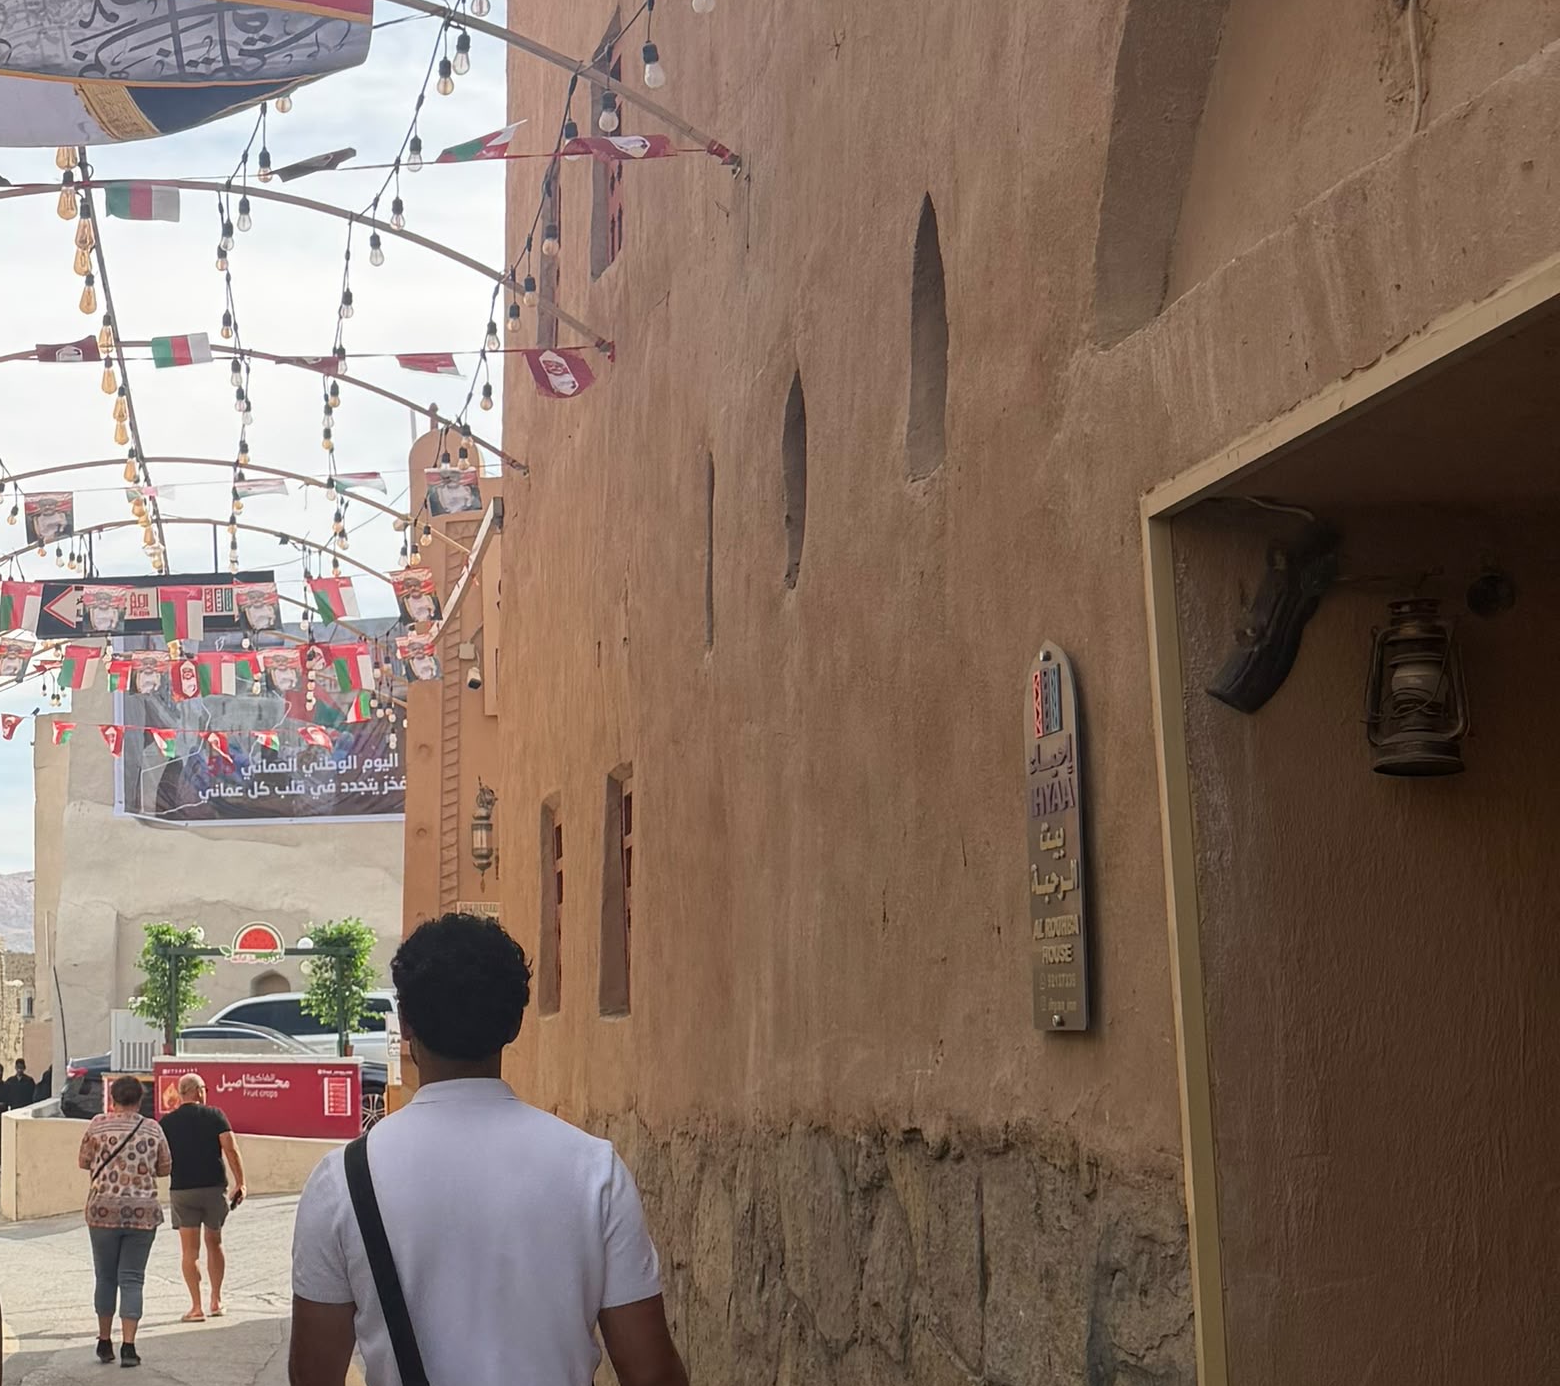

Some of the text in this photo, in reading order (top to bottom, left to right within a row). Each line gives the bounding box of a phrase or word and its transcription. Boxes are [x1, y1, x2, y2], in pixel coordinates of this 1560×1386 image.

[241, 757, 297, 780] العماني
[303, 754, 357, 778] الوطني
[362, 753, 399, 775] اليوم
[198, 782, 243, 803] عماني
[247, 780, 271, 799] كل
[274, 779, 305, 799] قلب
[310, 778, 336, 800] في
[341, 778, 379, 795] يتجدد
[1032, 918, 1044, 940] AL
[1041, 944, 1073, 965] HOUSE
